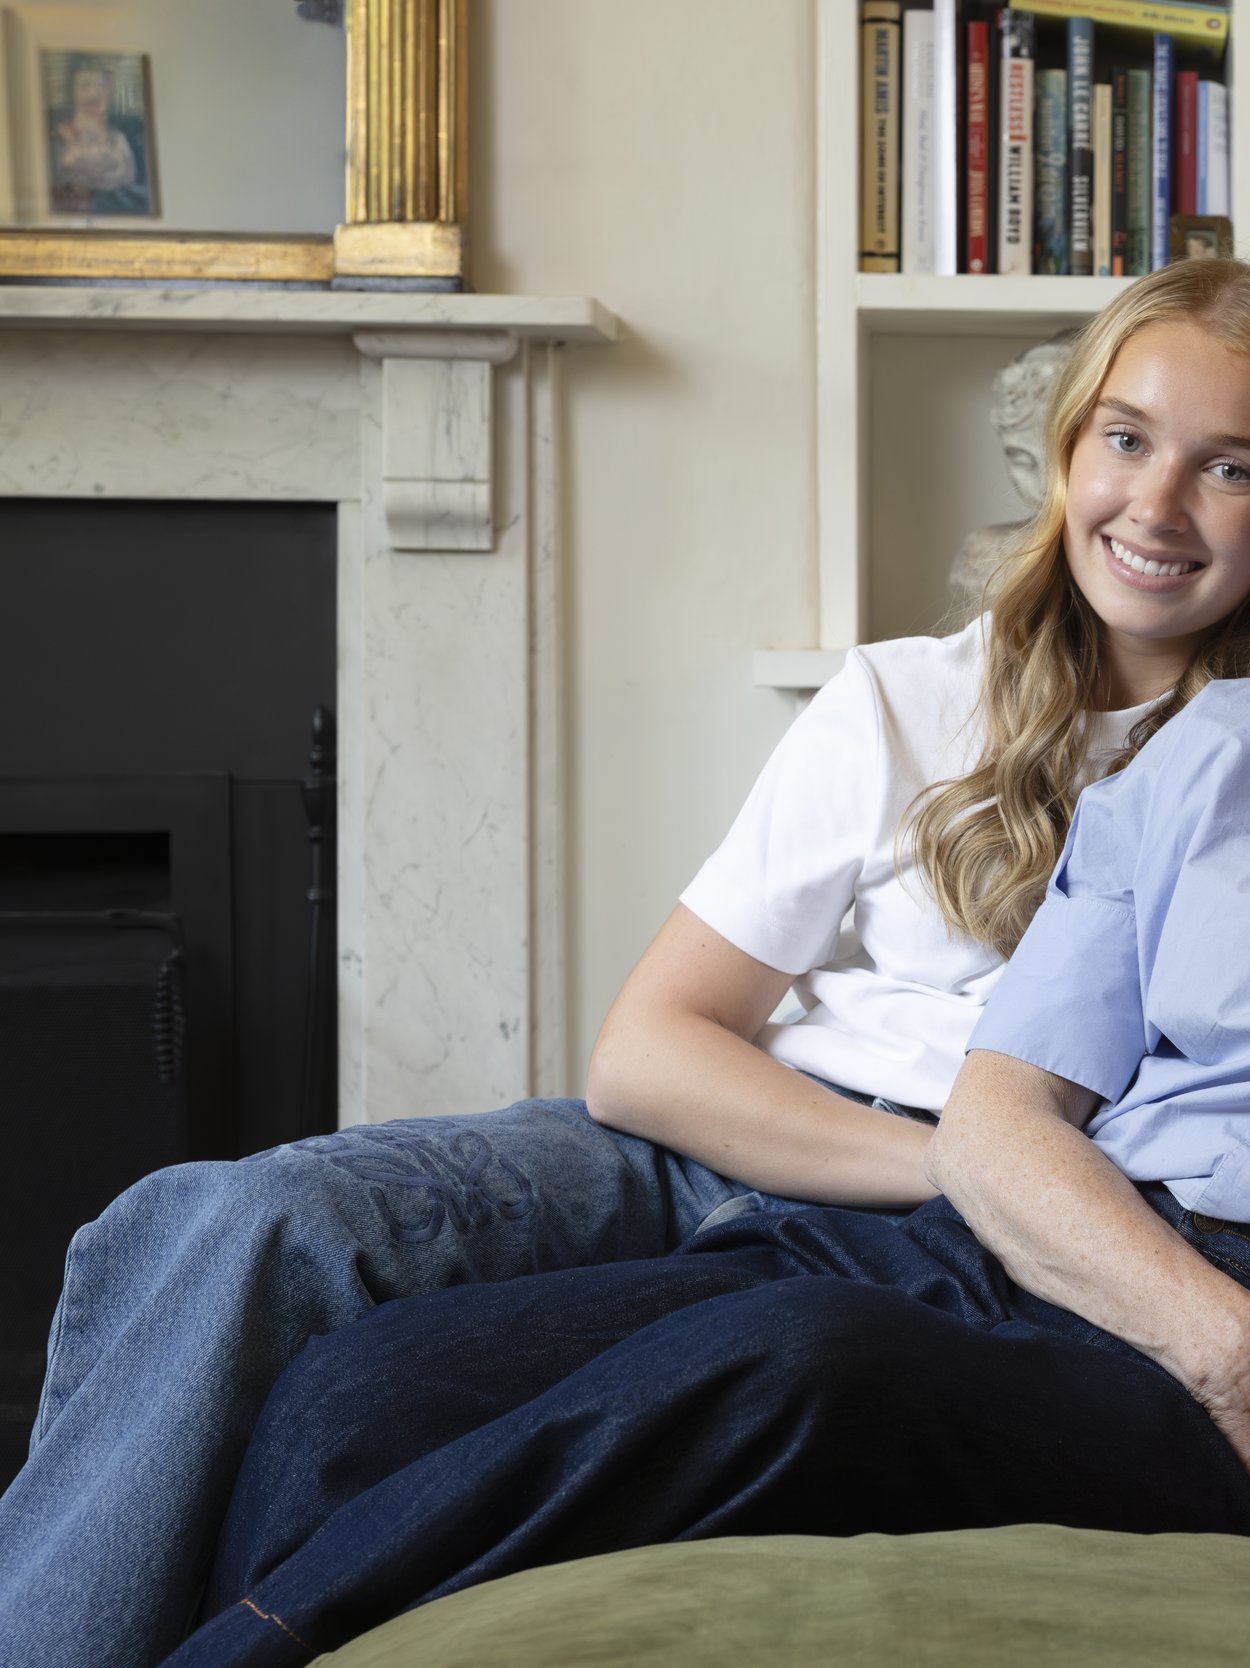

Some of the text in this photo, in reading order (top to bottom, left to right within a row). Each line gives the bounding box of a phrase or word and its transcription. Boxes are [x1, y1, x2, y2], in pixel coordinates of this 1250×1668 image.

[876, 29, 890, 114] MARTIN AMIS
[1072, 36, 1090, 76] JOHN
[1008, 64, 1024, 131] RESTLESS
[1072, 80, 1089, 98] LE
[877, 119, 886, 137] THE
[877, 185, 886, 234] INTEREST
[1007, 145, 1022, 244] WILLIAM BOYD
[1072, 175, 1089, 252] SILVERVIEW
